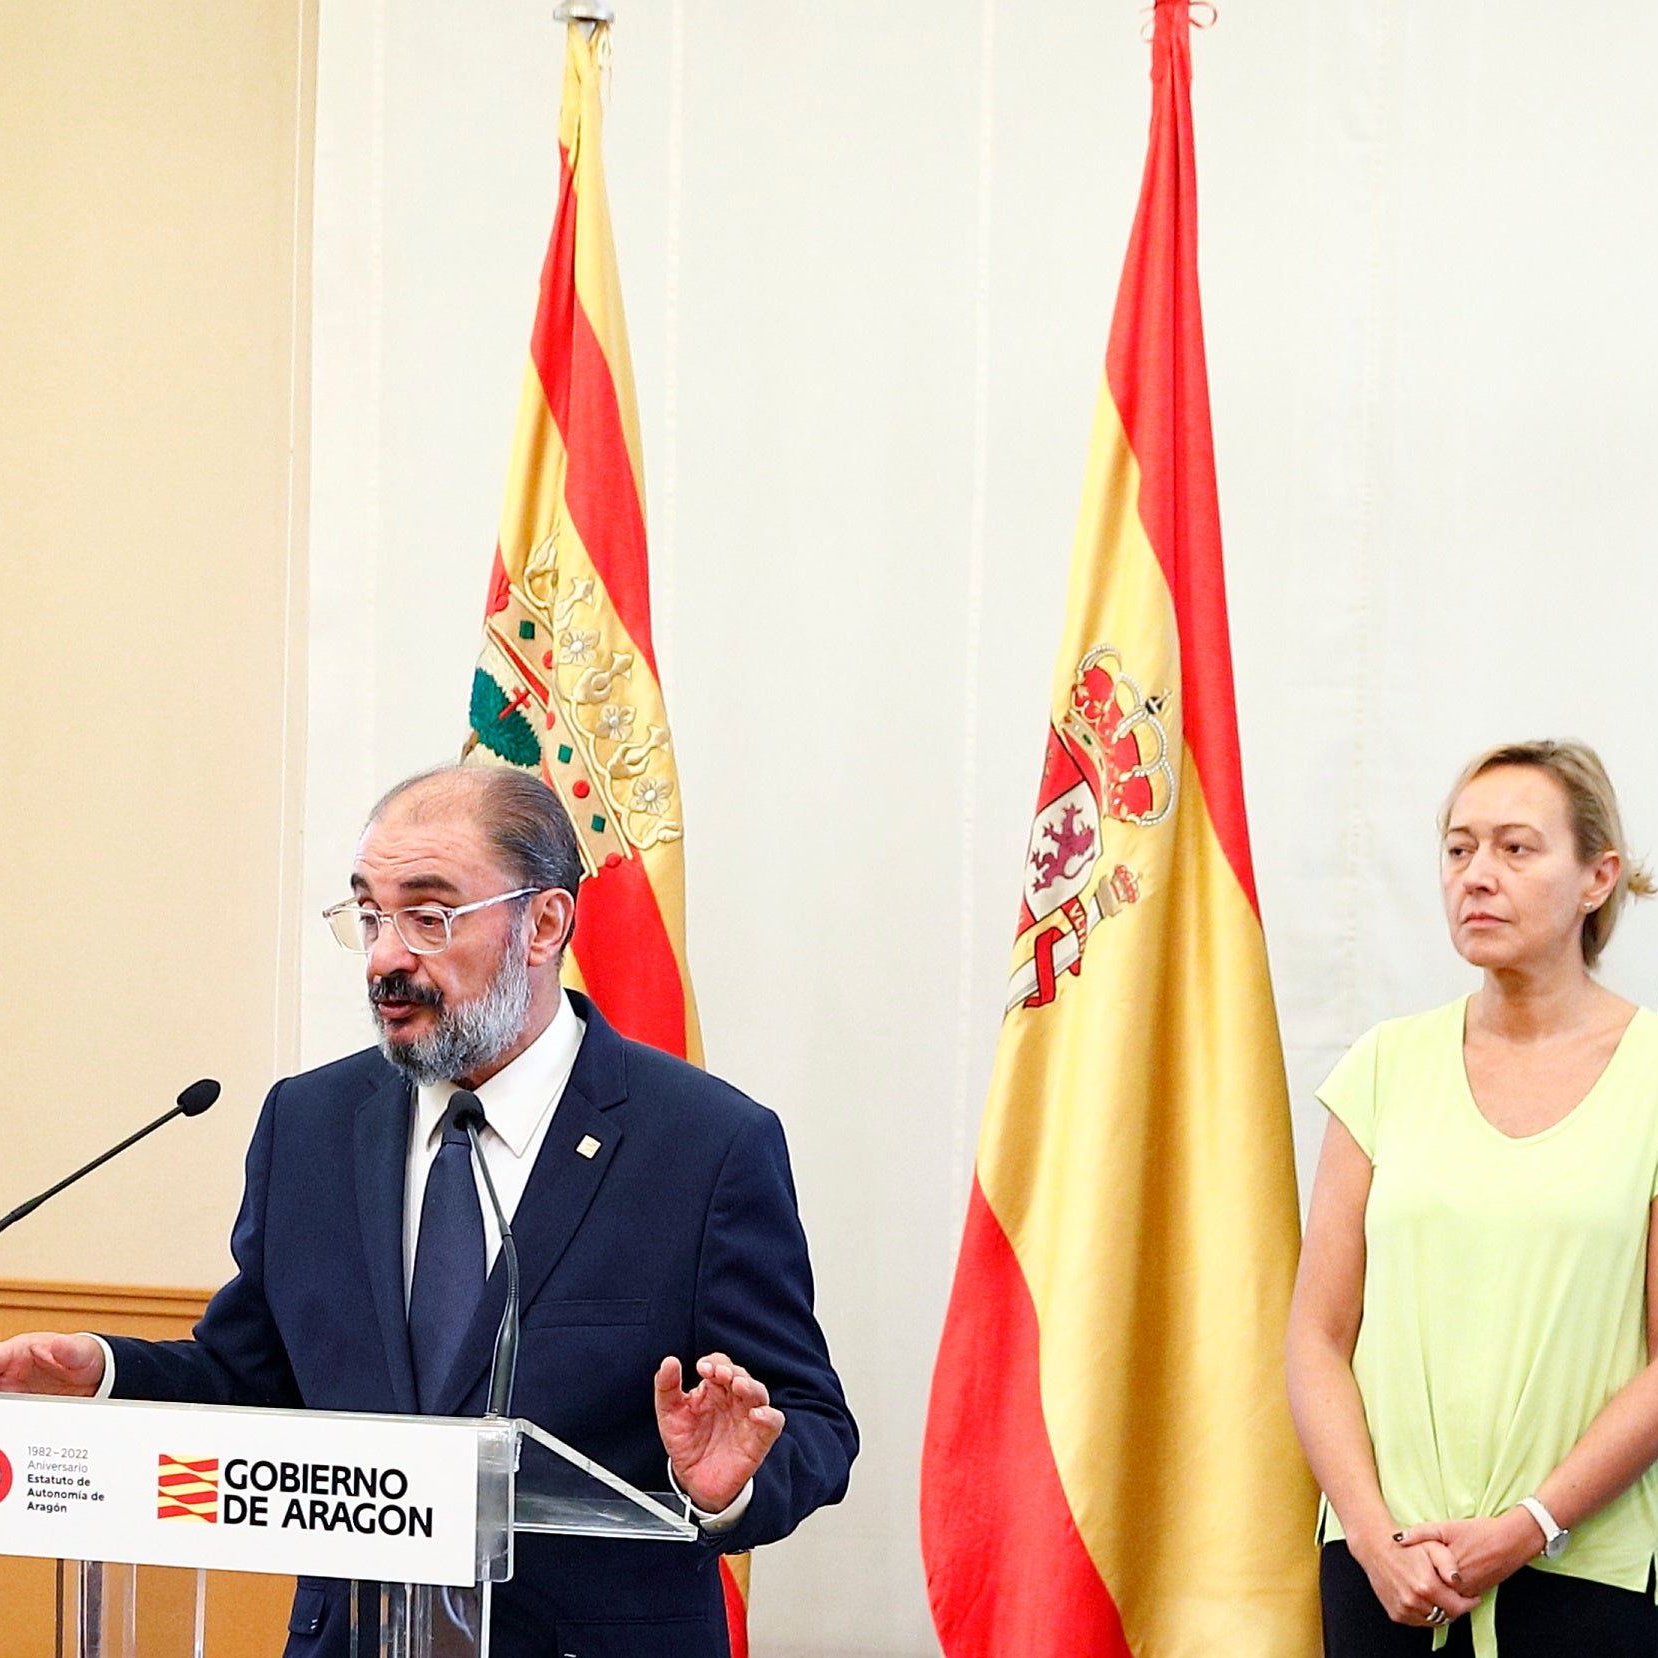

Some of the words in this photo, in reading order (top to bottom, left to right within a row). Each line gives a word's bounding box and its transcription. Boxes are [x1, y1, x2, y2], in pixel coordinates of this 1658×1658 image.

[27, 1460, 88, 1474] Aniversario
[27, 1474, 75, 1486] Estatuto
[77, 1476, 91, 1487] de
[224, 1458, 408, 1500] GOBIERNO
[27, 1488, 88, 1501] Autonomía
[91, 1491, 105, 1502] de
[27, 1501, 67, 1514] Aragón
[223, 1493, 269, 1527] DE
[281, 1498, 433, 1538] ARAGON
